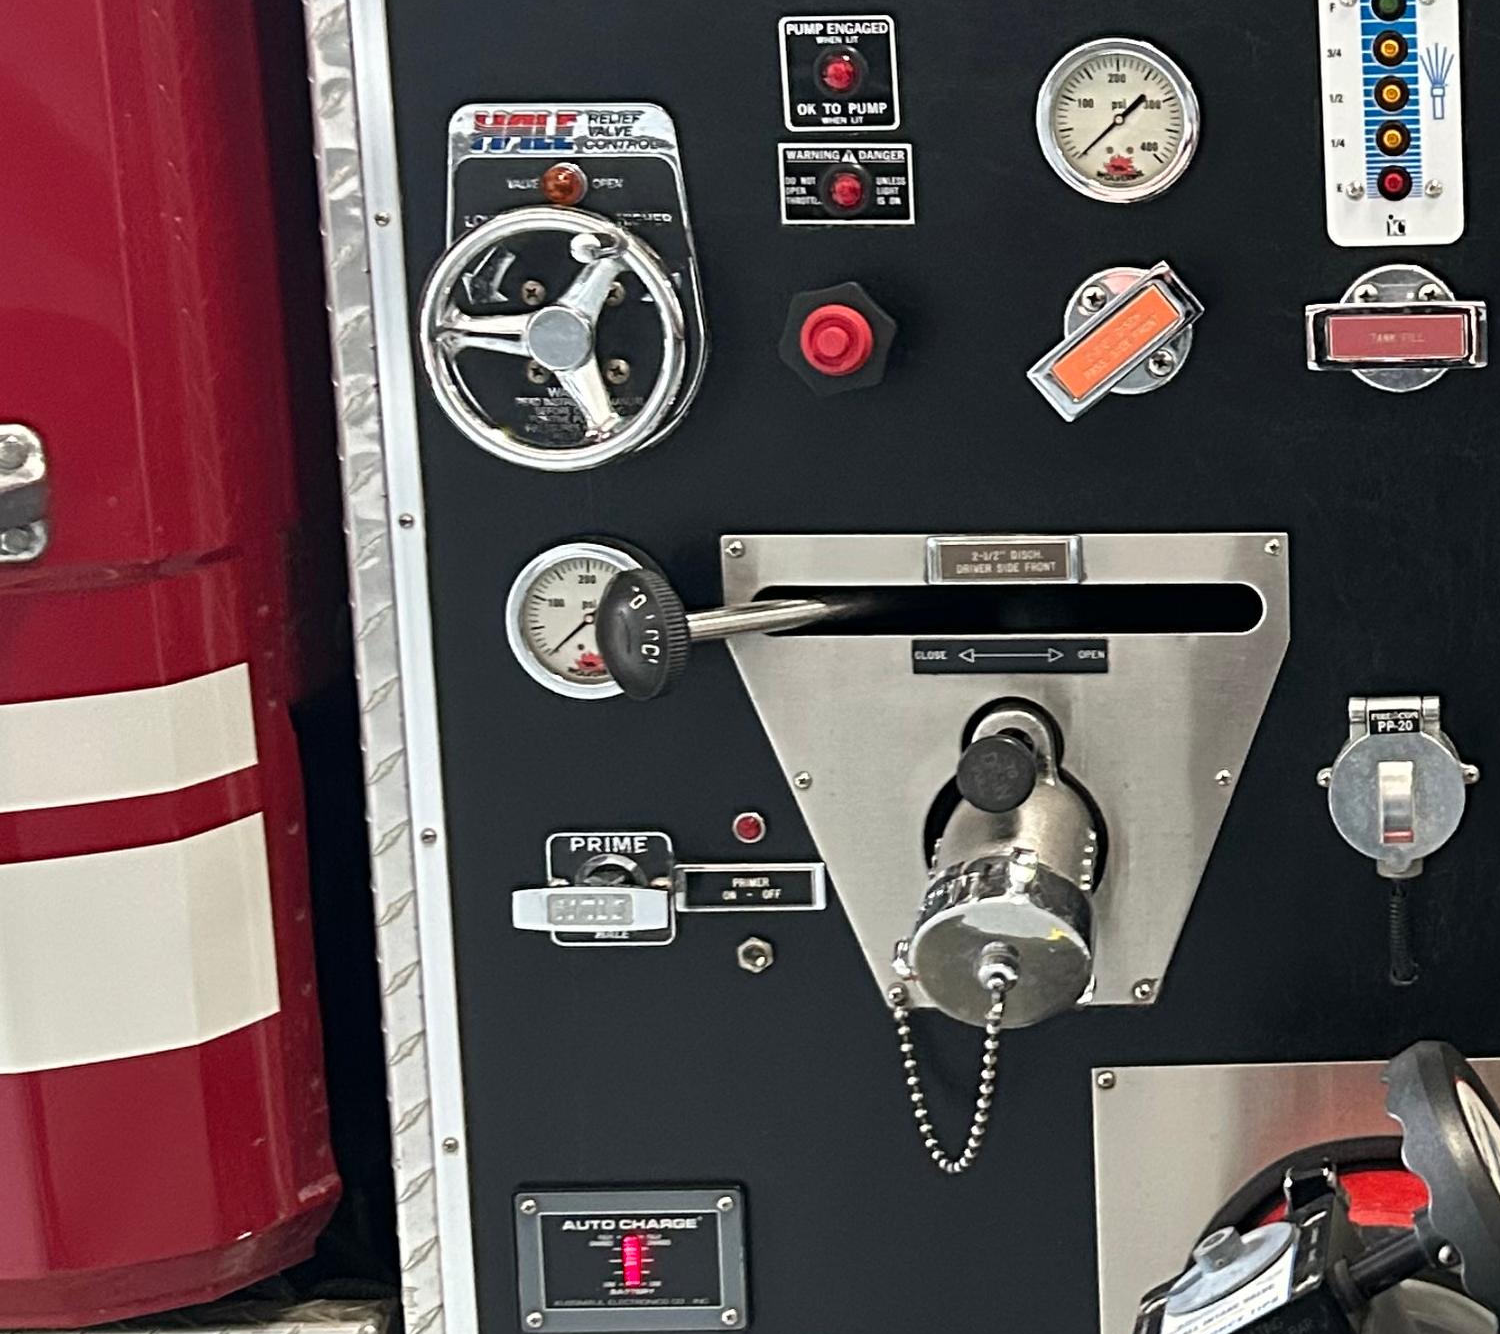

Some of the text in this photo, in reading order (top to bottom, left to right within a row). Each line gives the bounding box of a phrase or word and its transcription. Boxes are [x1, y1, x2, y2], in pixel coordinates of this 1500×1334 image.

[786, 22, 888, 35] PUMP ENGAGED
[1327, 49, 1342, 58] 3/4
[1108, 74, 1126, 83] 200
[1078, 99, 1094, 108] 100
[1329, 94, 1344, 104] 1/2
[797, 103, 887, 115] OK TO PUMP
[1112, 100, 1127, 111] psi
[588, 112, 641, 125] RELIEF
[589, 126, 633, 137] VALVE
[584, 139, 661, 150] CONTROL
[1331, 139, 1345, 149] 1/4
[786, 151, 905, 160] WARNING DANGER
[507, 178, 624, 189] VALVE OPEN
[1369, 333, 1395, 342] TANK
[956, 561, 1056, 575] DRIVER SIDE FRONT
[578, 575, 596, 584] 200
[914, 650, 1105, 660] CLOSE OPEN
[1378, 720, 1413, 732] PP-20
[570, 837, 648, 853] PRIME
[732, 878, 770, 887] PRIMER
[722, 889, 782, 900] ON OFF
[562, 1219, 616, 1231] AUTO
